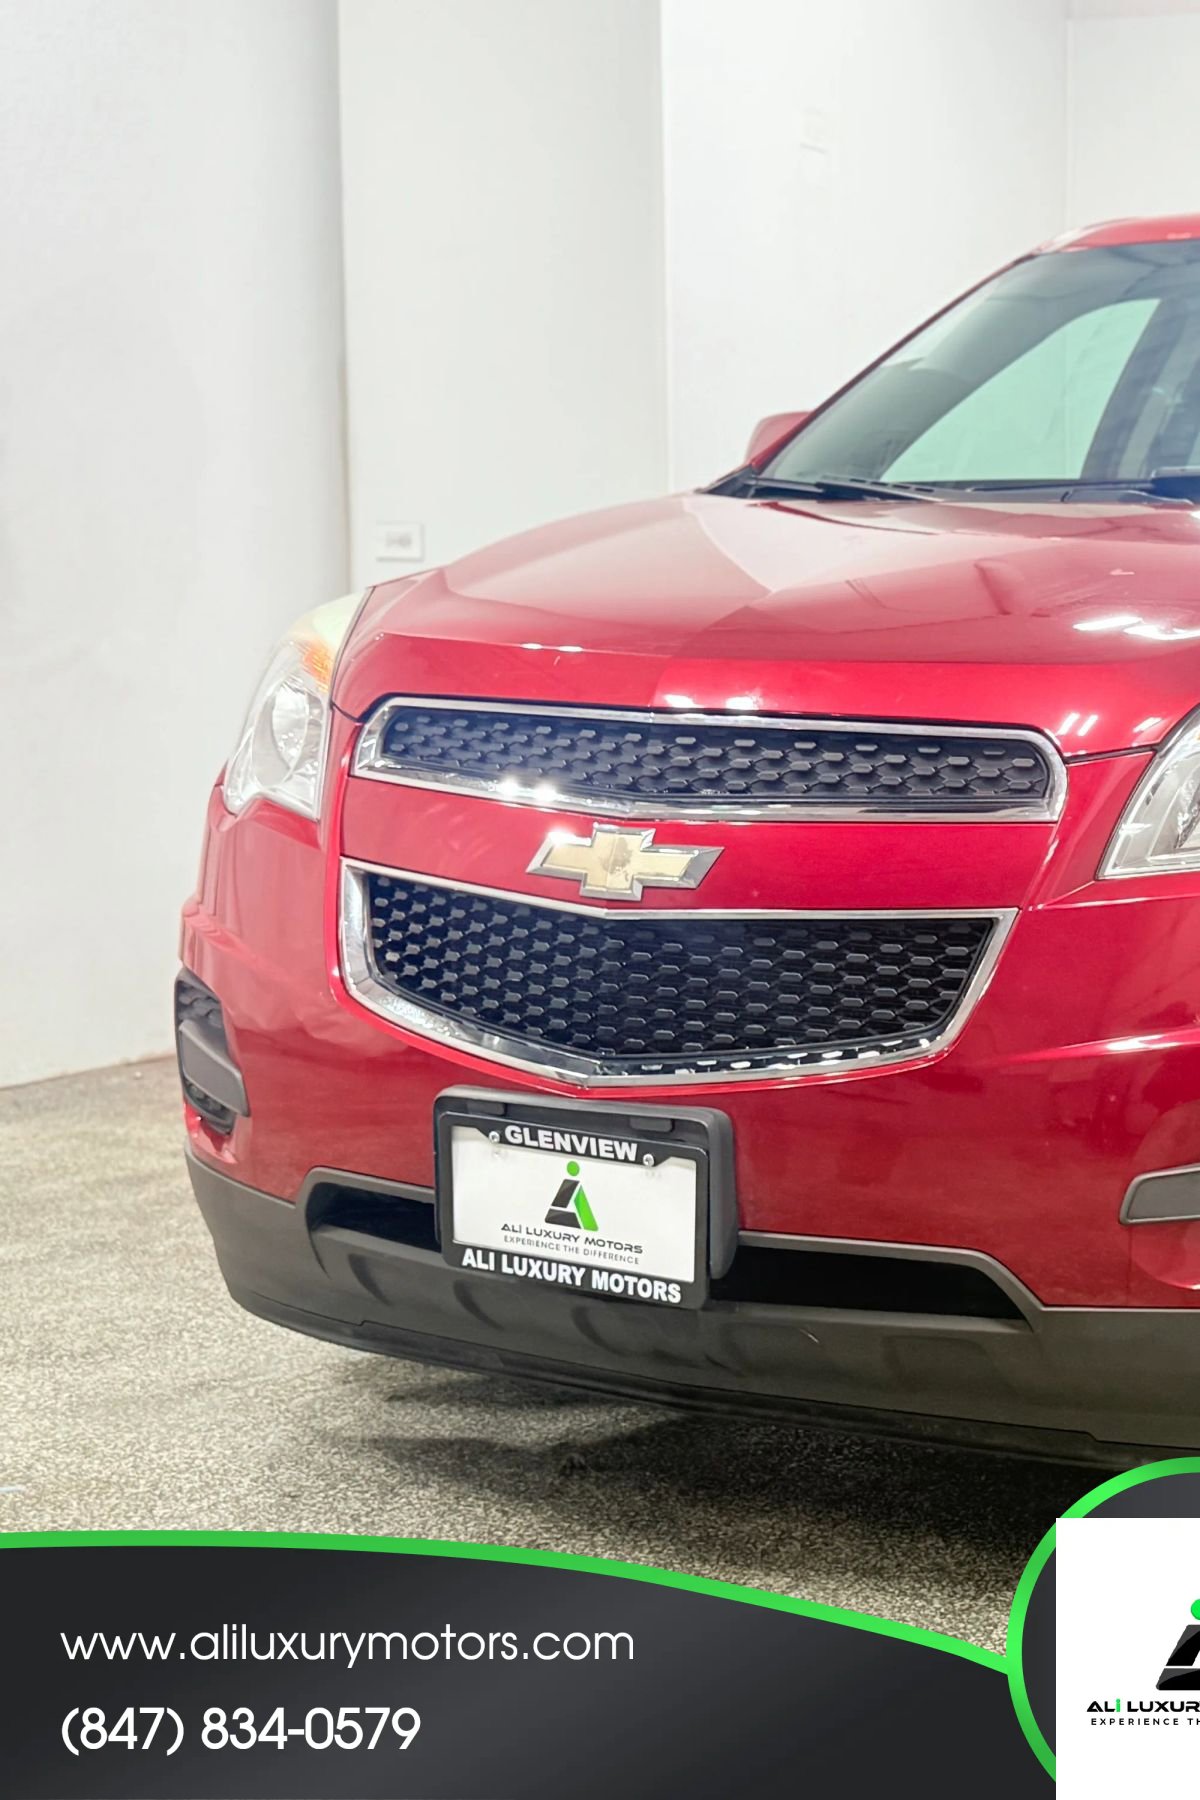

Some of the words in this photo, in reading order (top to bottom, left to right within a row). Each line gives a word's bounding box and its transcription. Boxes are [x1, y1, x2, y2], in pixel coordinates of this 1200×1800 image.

[504, 1125, 638, 1163] GLENVIEW
[504, 1235, 561, 1252] EXPERIENCE
[563, 1244, 580, 1255] THE
[583, 1247, 640, 1265] DIFFERENCE
[525, 1227, 580, 1243] LUXURY
[584, 1237, 643, 1255] MOTORS
[461, 1247, 495, 1271] ALI
[501, 1254, 586, 1287] LUXURY
[591, 1269, 682, 1304] MOTORS
